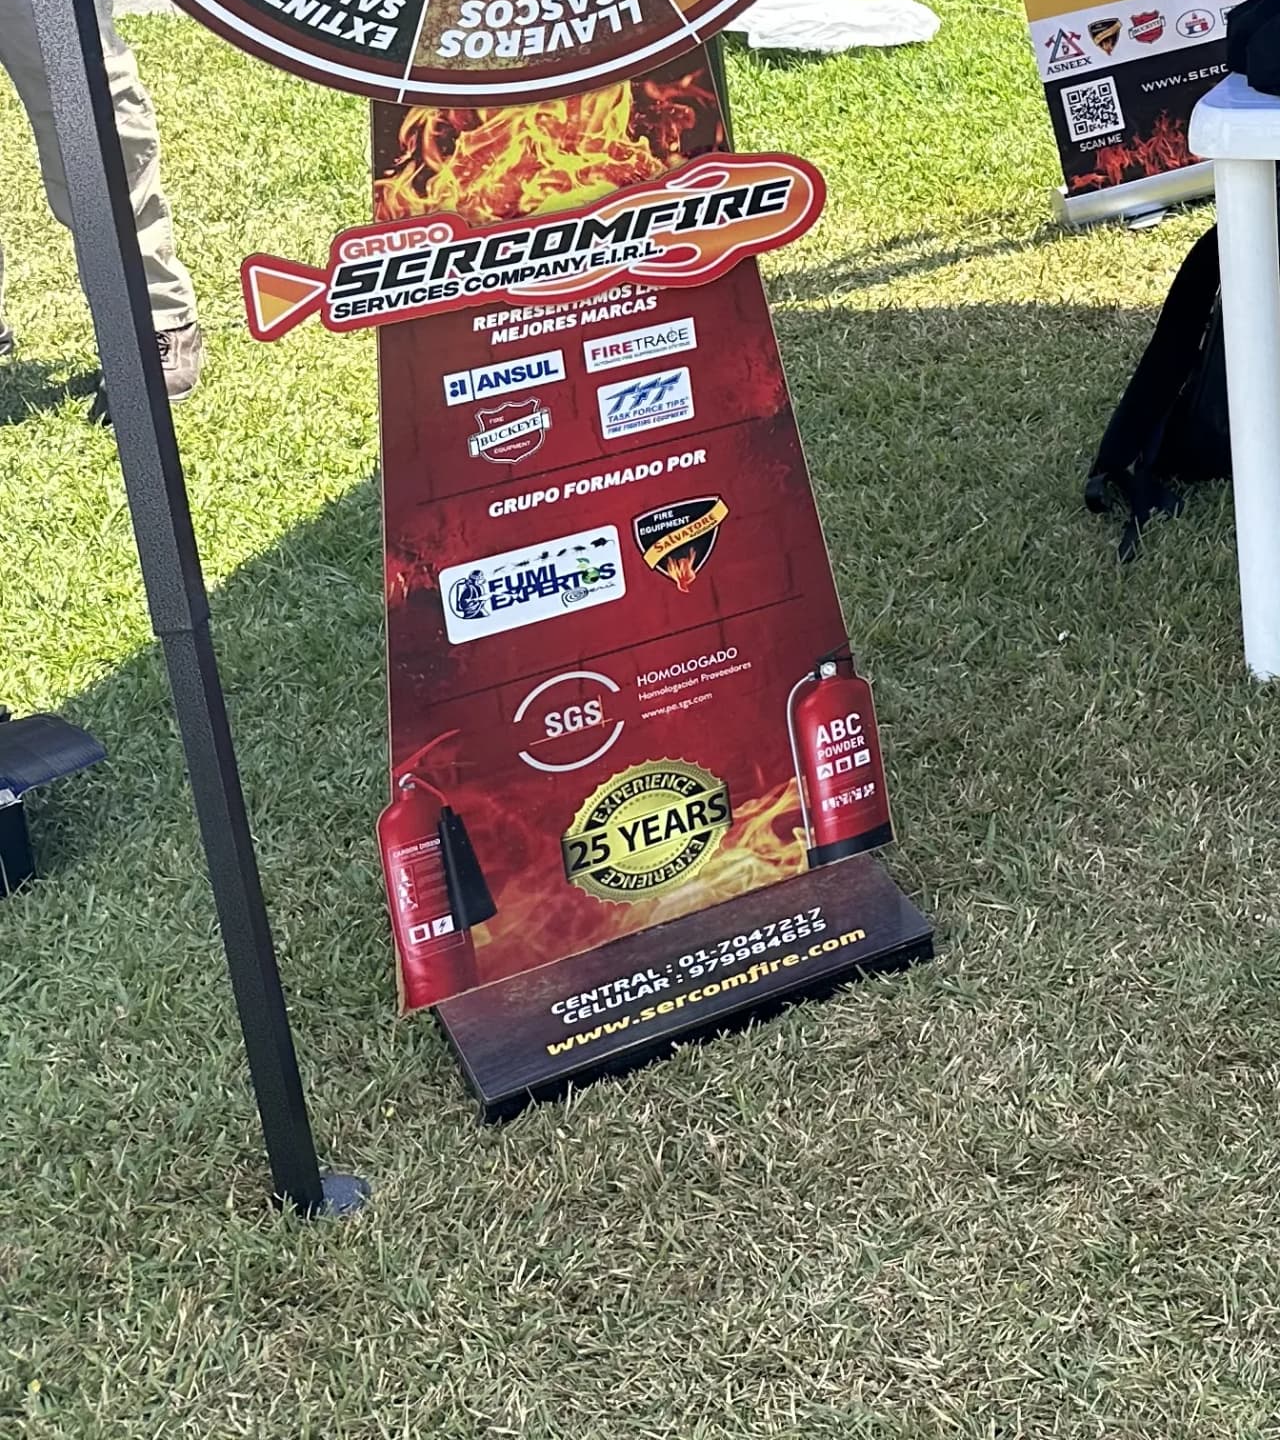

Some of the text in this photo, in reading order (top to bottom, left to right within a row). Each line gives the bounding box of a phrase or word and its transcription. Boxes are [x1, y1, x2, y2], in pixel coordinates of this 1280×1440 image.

[1046, 56, 1092, 75] ASNEEX
[1079, 134, 1123, 152] SCAN ME
[331, 179, 792, 300] SERCOMFIRE
[343, 226, 450, 260] GRUPO
[333, 242, 664, 320] SERVICES COMPANY E.I.R.L.
[491, 296, 657, 345] MEJORES MARCAS
[591, 327, 689, 360] FIRETRACE
[477, 360, 559, 391] ANSUL
[480, 415, 540, 447] BUCKEYE
[608, 412, 631, 423] TASK
[633, 405, 663, 417] FORCE
[489, 449, 707, 517] GRUPO FORMADO POR
[640, 516, 690, 536] EQUIPMENT
[653, 510, 674, 521] FIRE
[489, 564, 558, 593] FUMI
[637, 647, 738, 687] HOMOLOGADO
[701, 661, 752, 683] Proveedores
[544, 699, 603, 738] SGS
[816, 713, 862, 748] ABC
[817, 735, 865, 760] POWDER
[592, 774, 696, 824] EXPERIENCE
[569, 792, 726, 872] 25 YEARS
[601, 839, 705, 889] EXPERIENCE
[551, 907, 822, 1015] CENTRAL 01-7047217
[563, 919, 827, 1025] CELULAR 979984655
[545, 927, 867, 1056] www.sercomfire.com
